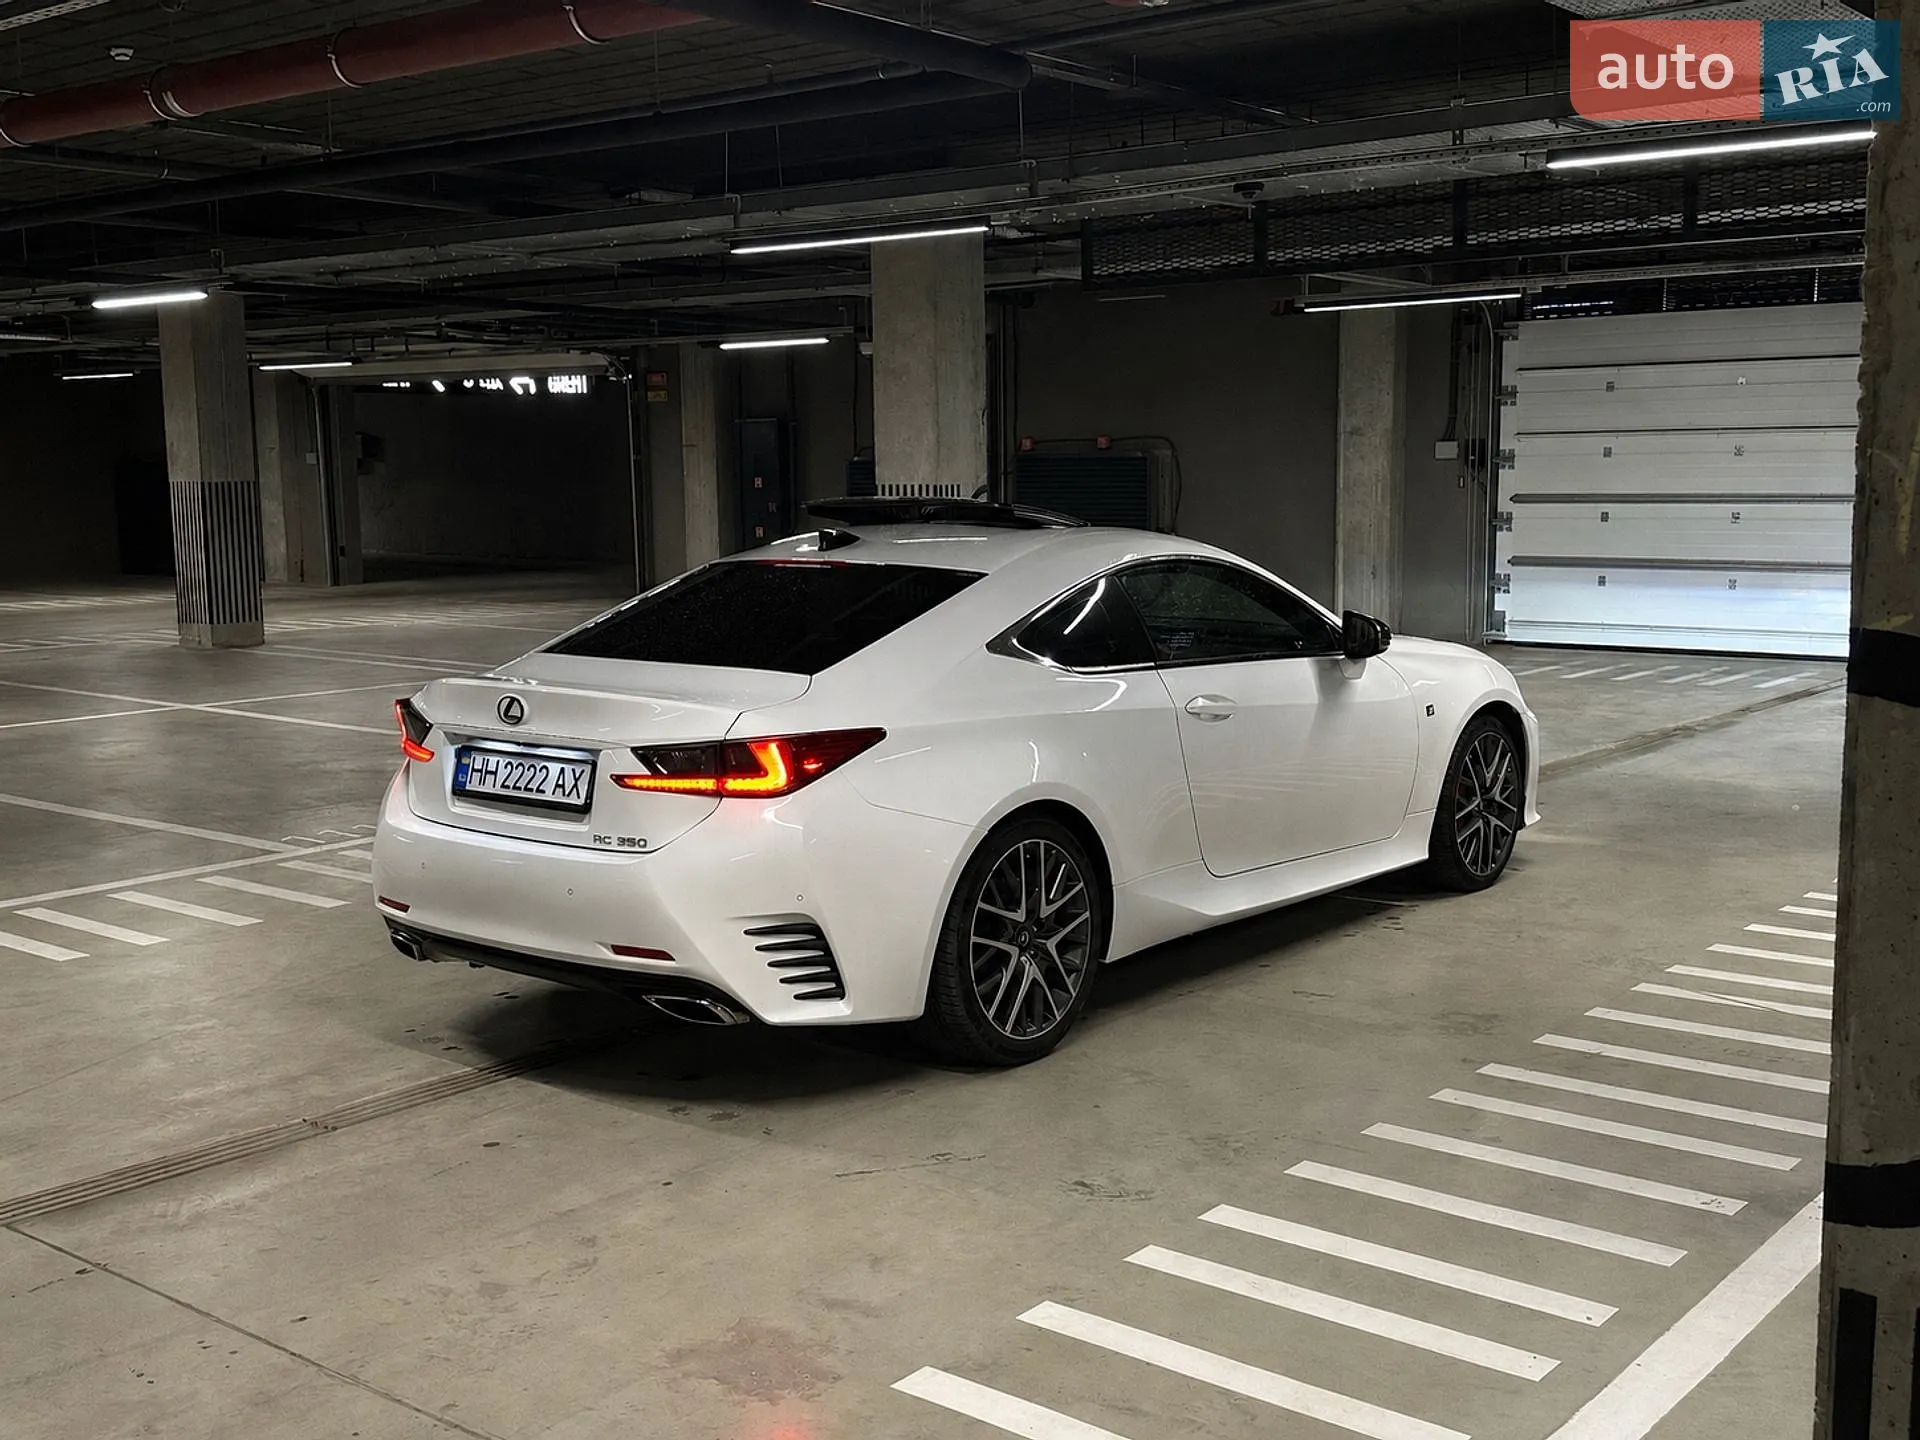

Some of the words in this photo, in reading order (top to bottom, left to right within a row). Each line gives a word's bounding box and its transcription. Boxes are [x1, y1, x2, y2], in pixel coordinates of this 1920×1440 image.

[468, 755, 500, 788] HH
[500, 761, 550, 794] 2222
[552, 767, 585, 799] AX
[593, 834, 612, 845] RC
[616, 836, 648, 848] 350
